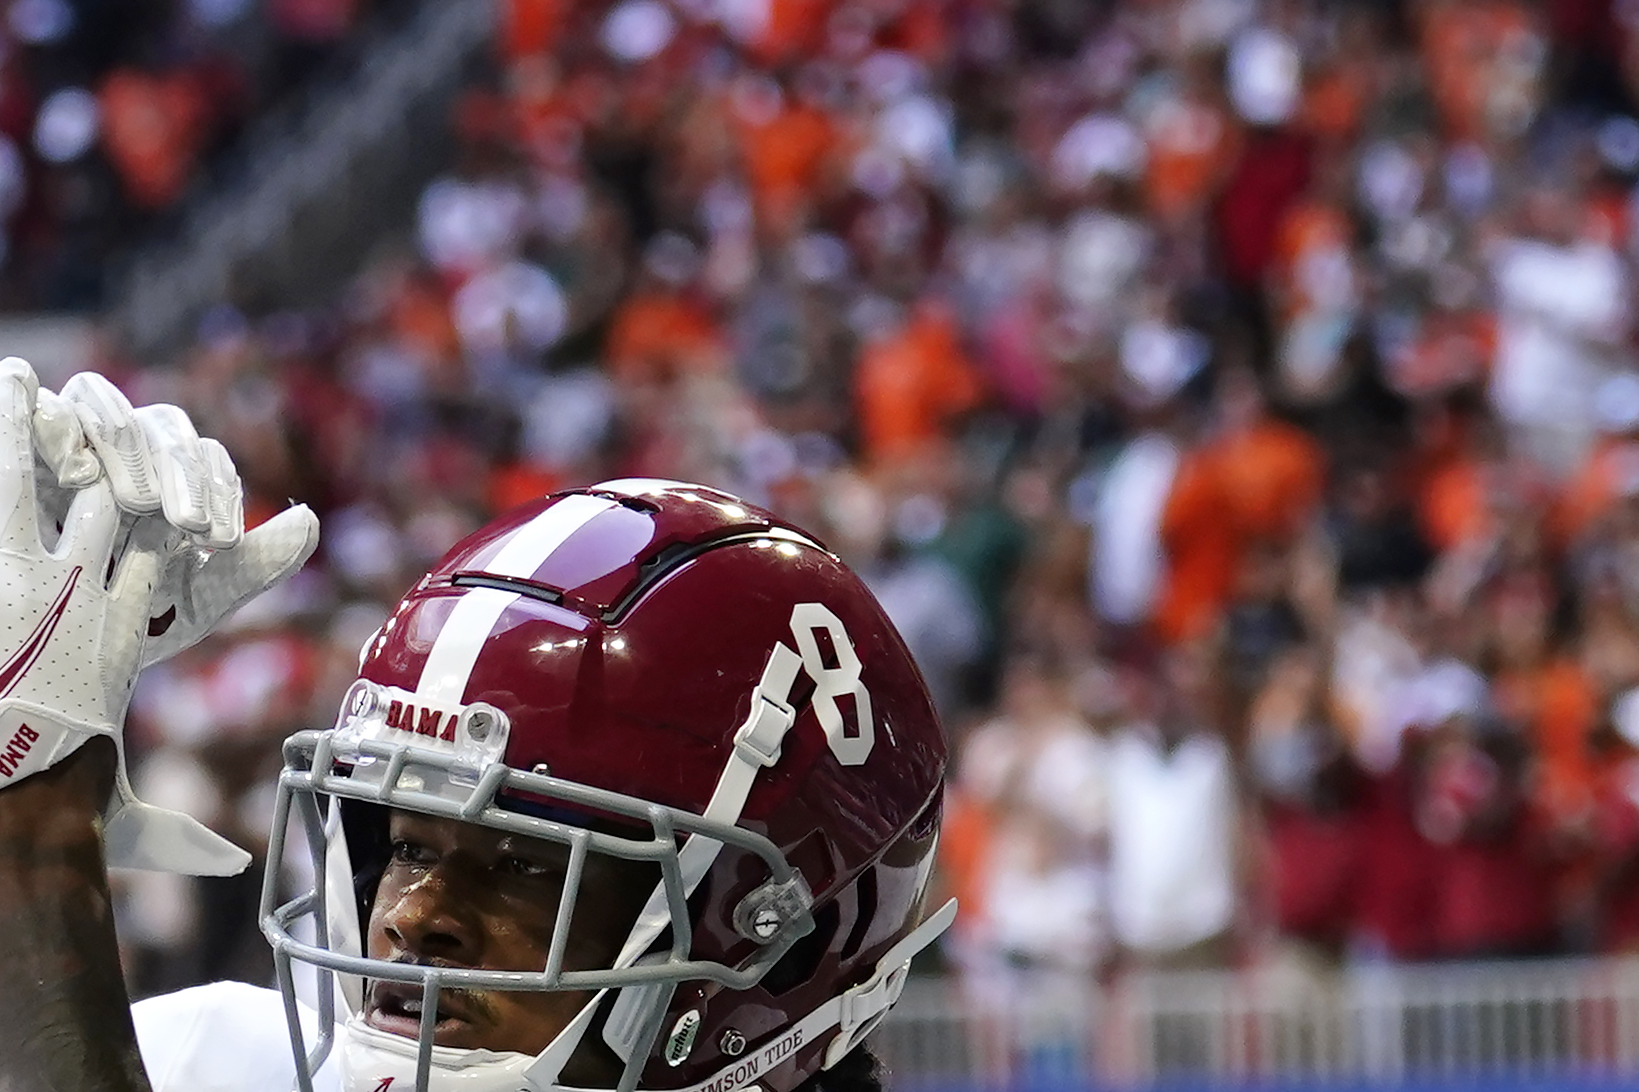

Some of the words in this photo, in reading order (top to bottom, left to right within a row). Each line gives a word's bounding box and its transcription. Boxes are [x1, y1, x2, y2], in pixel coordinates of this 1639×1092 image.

[789, 603, 875, 766] 8
[386, 700, 459, 742] BAMA
[764, 1028, 805, 1066] TIDE
